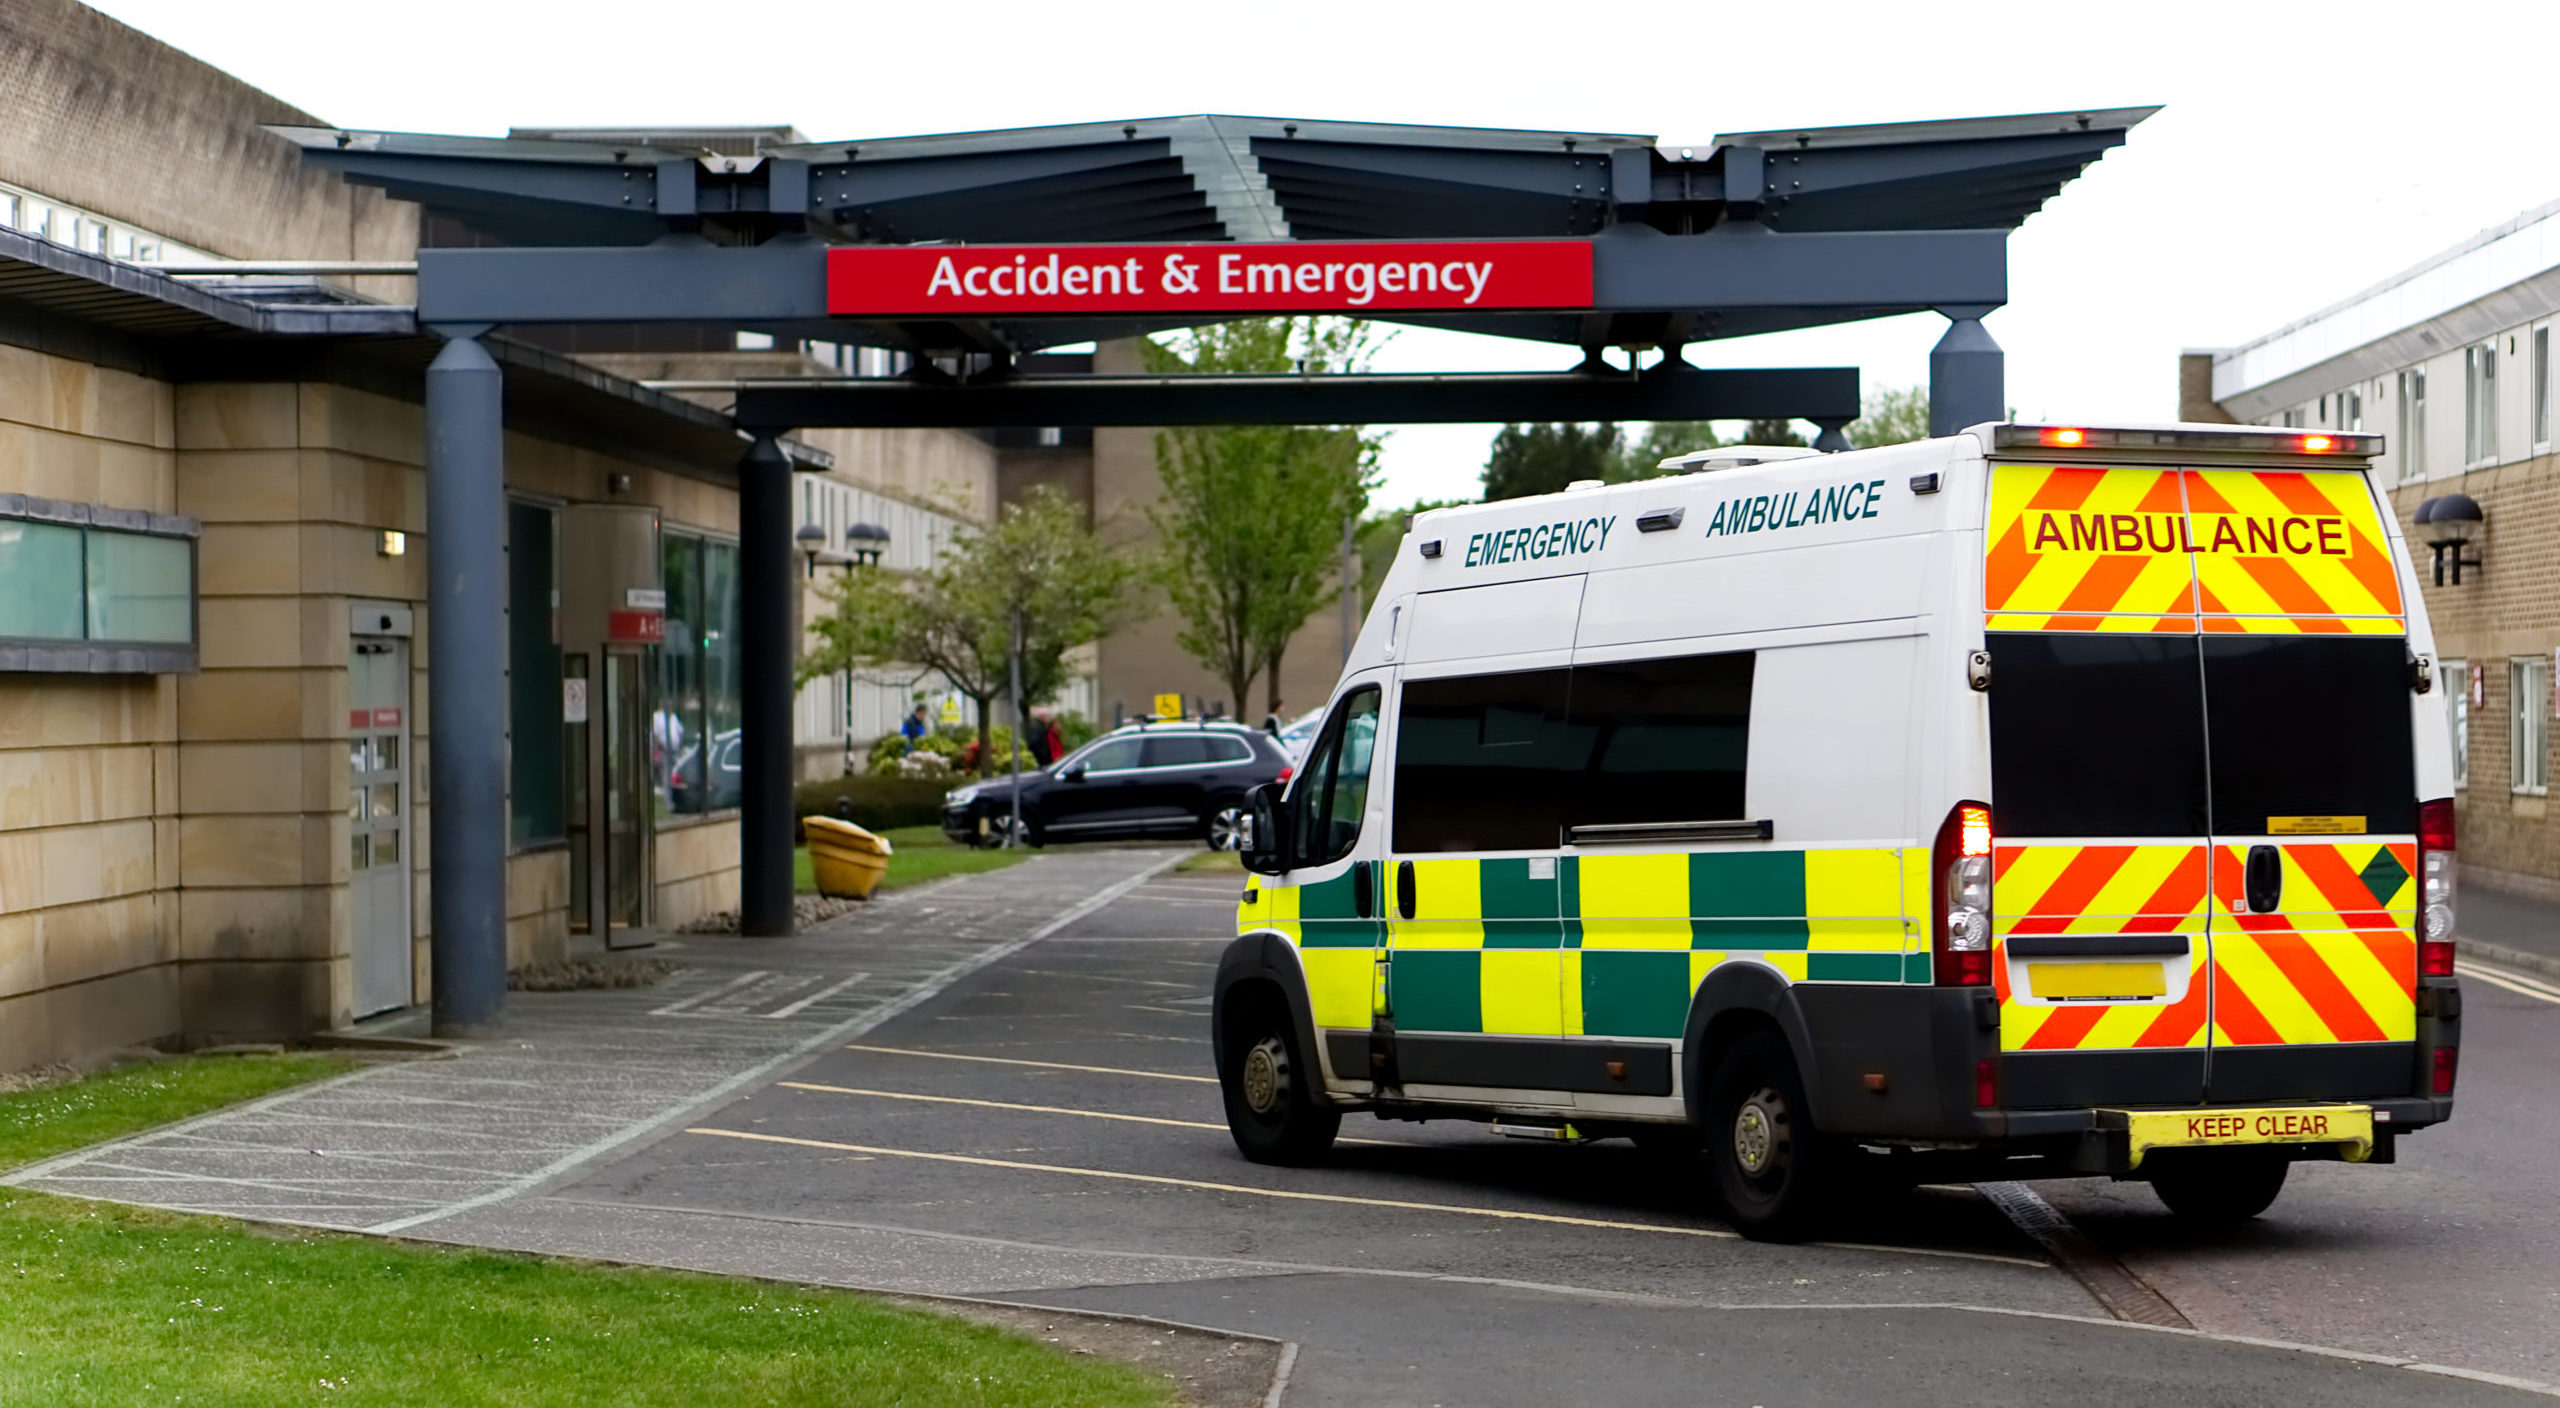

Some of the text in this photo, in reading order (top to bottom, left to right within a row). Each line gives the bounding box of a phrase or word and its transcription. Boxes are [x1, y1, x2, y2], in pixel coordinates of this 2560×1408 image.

[927, 254, 1493, 304] Accident & Emergency
[1464, 480, 1886, 568] EMERGENCY AMBULANCE
[2034, 513, 2346, 555] AMBULANCE
[2187, 1115, 2328, 1138] KEEP CLEAR
